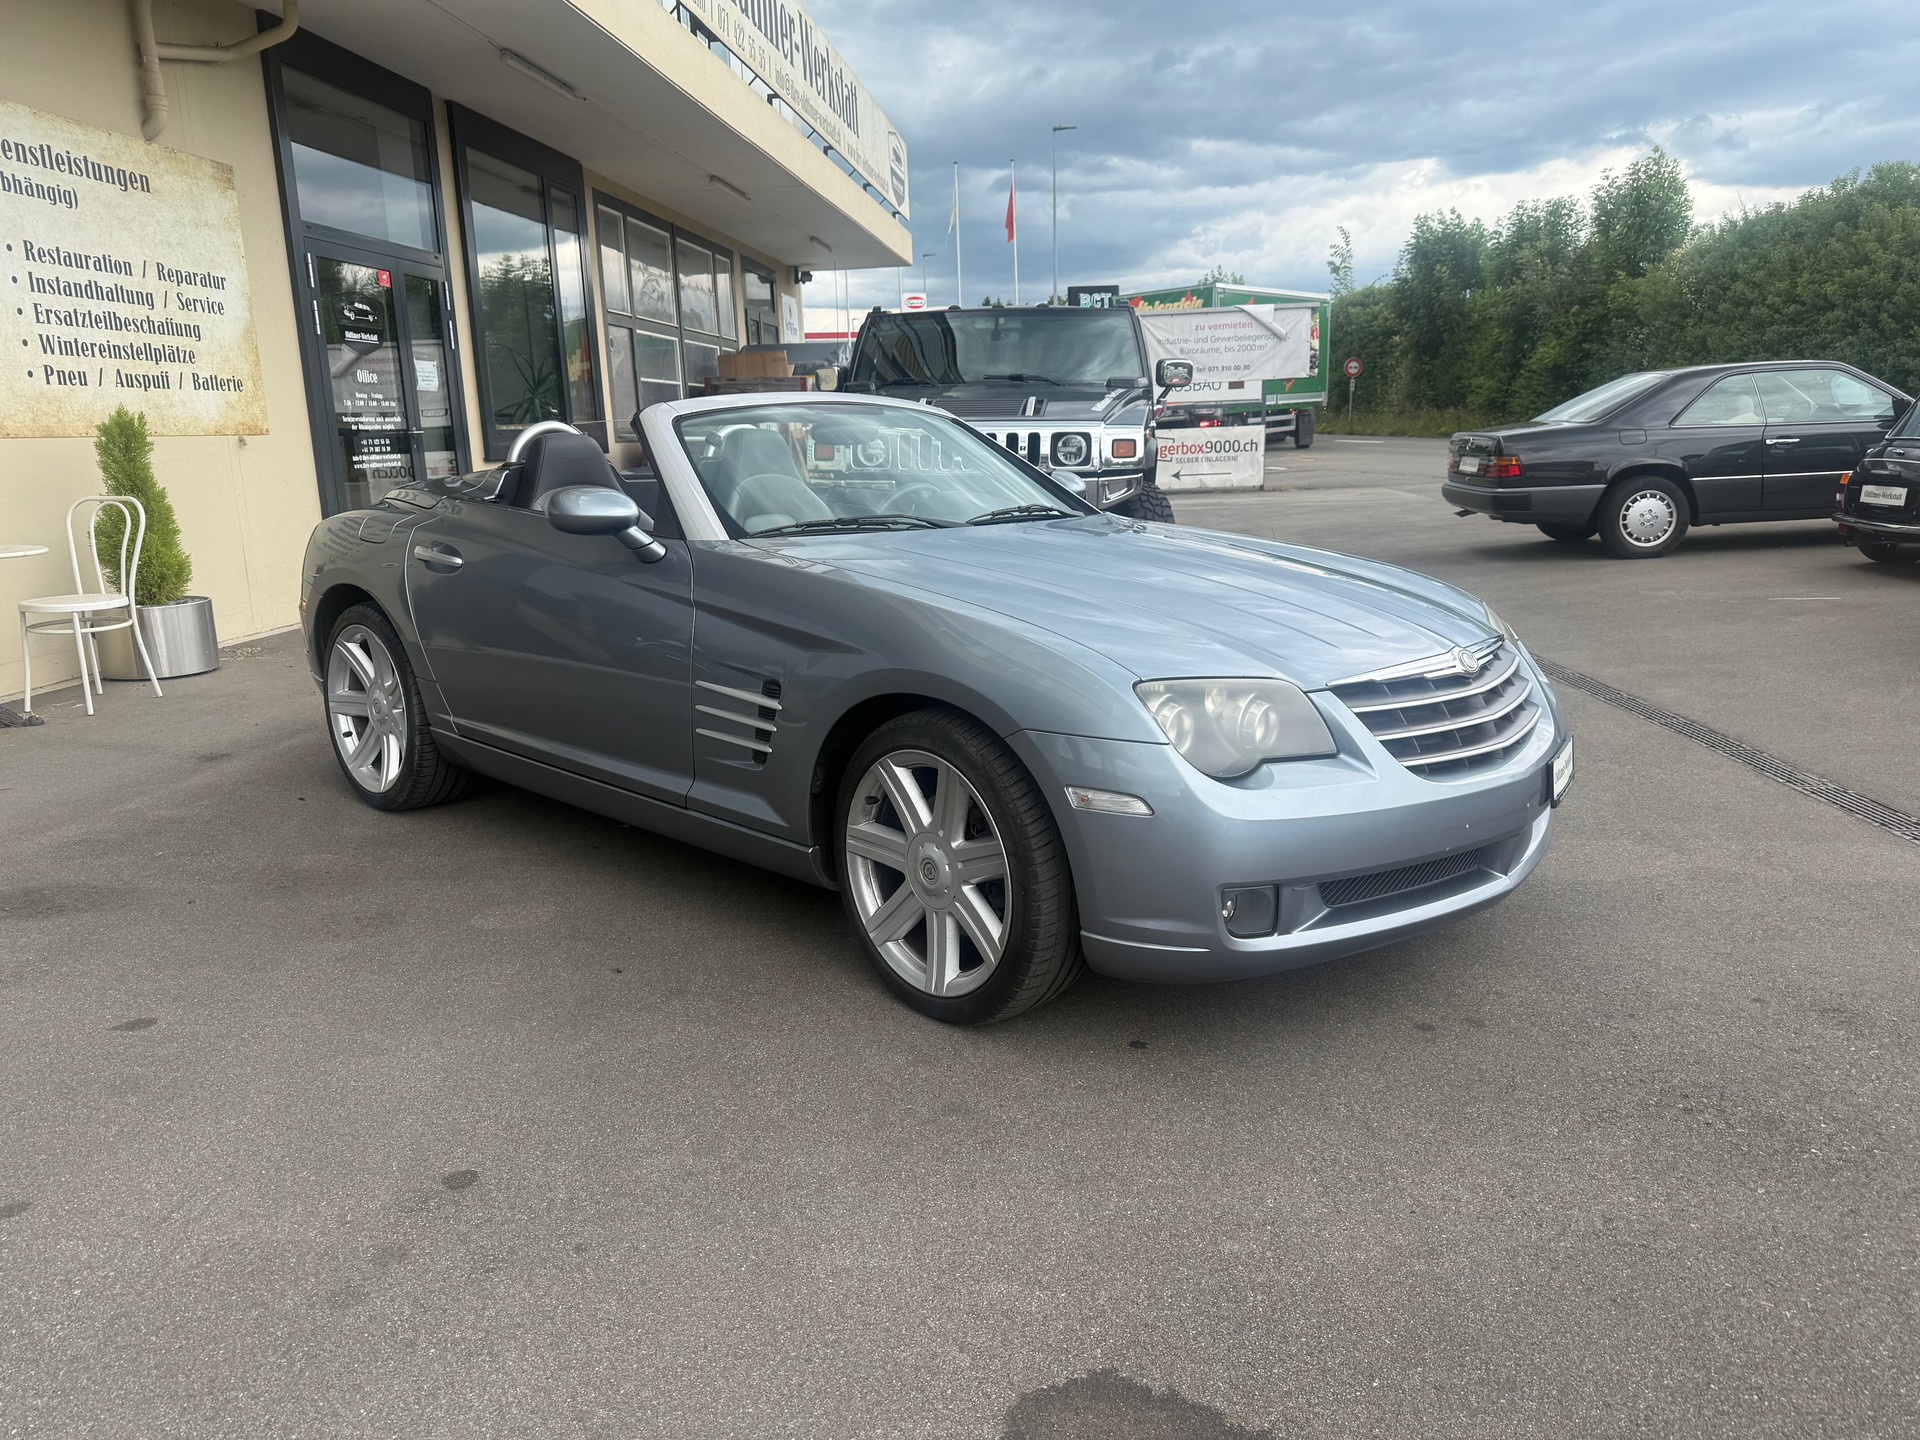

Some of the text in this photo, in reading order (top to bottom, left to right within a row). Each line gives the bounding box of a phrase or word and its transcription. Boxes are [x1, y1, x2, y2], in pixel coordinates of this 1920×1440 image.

[717, 3, 730, 38] 071
[734, 20, 745, 52] 422
[748, 34, 756, 63] 55
[758, 45, 766, 73] 55
[730, 0, 860, 139] mer-Werkstatt
[0, 138, 152, 193] enstleistungen
[0, 170, 78, 210] bhängig)
[23, 239, 133, 277] Restauration
[156, 261, 227, 290] Reparatur
[27, 271, 155, 310] Instandhaltung
[176, 291, 225, 315] Service
[32, 302, 201, 342] Ersatzteilbeschaffung
[1208, 320, 1254, 331] vermieten
[38, 333, 196, 365] Wintereinstellplätze
[1157, 336, 1193, 345] Industrie-
[1193, 335, 1209, 344] und
[1180, 345, 1223, 355] Büroräume,
[1224, 344, 1235, 353] bis
[43, 364, 88, 387] Pneu
[115, 368, 171, 391] Auspuff
[192, 372, 244, 392] Batterie
[357, 369, 378, 383] Office
[1159, 438, 1258, 459] gerbox9000.ch
[1200, 455, 1239, 463] EINLAGERN!
